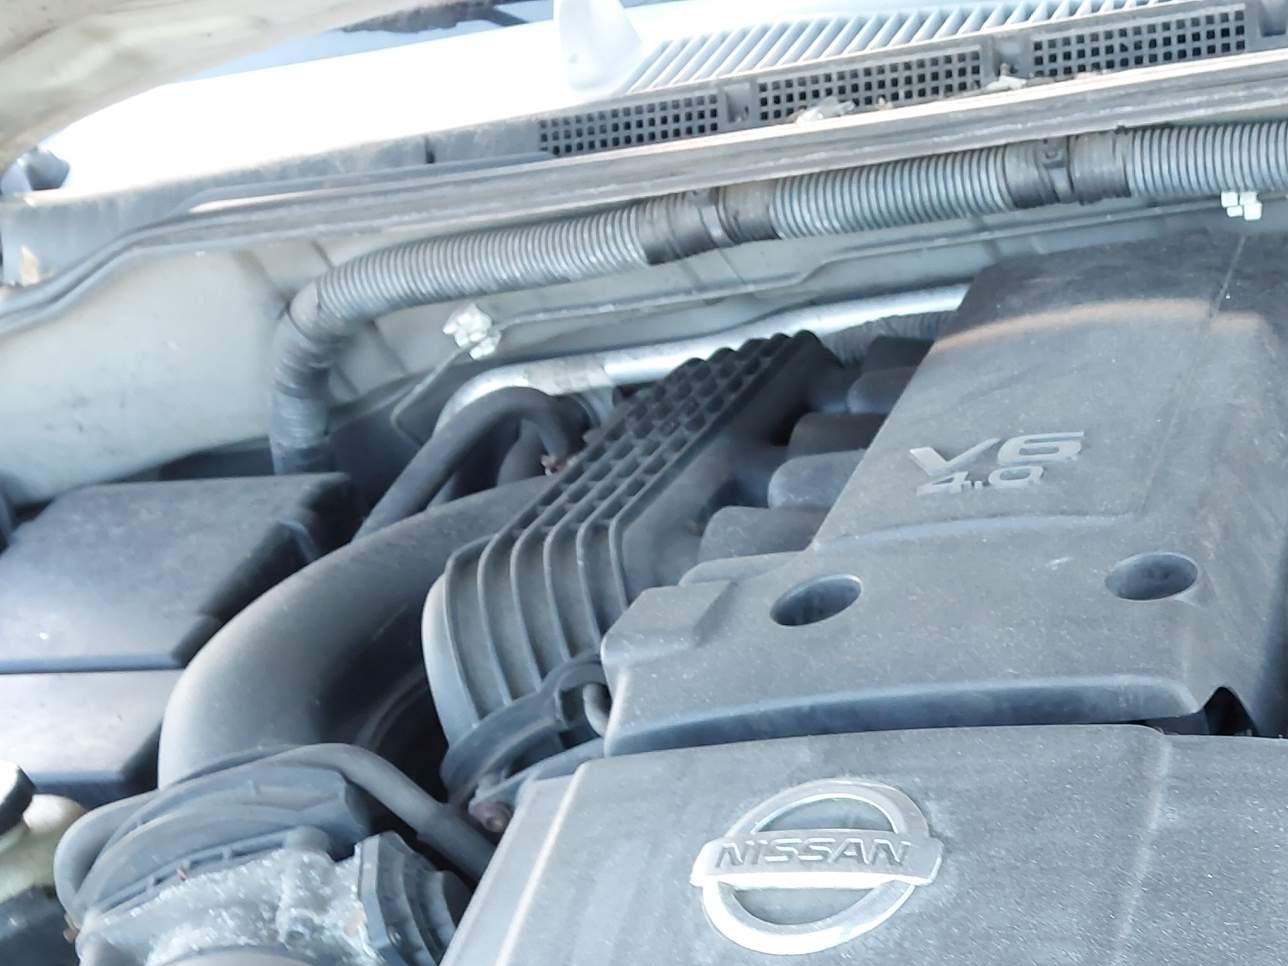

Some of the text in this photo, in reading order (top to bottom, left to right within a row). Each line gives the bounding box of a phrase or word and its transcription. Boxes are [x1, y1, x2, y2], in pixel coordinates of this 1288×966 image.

[909, 430, 1085, 477] V6
[916, 465, 1045, 496] 4.0
[715, 836, 912, 868] NISSAN
